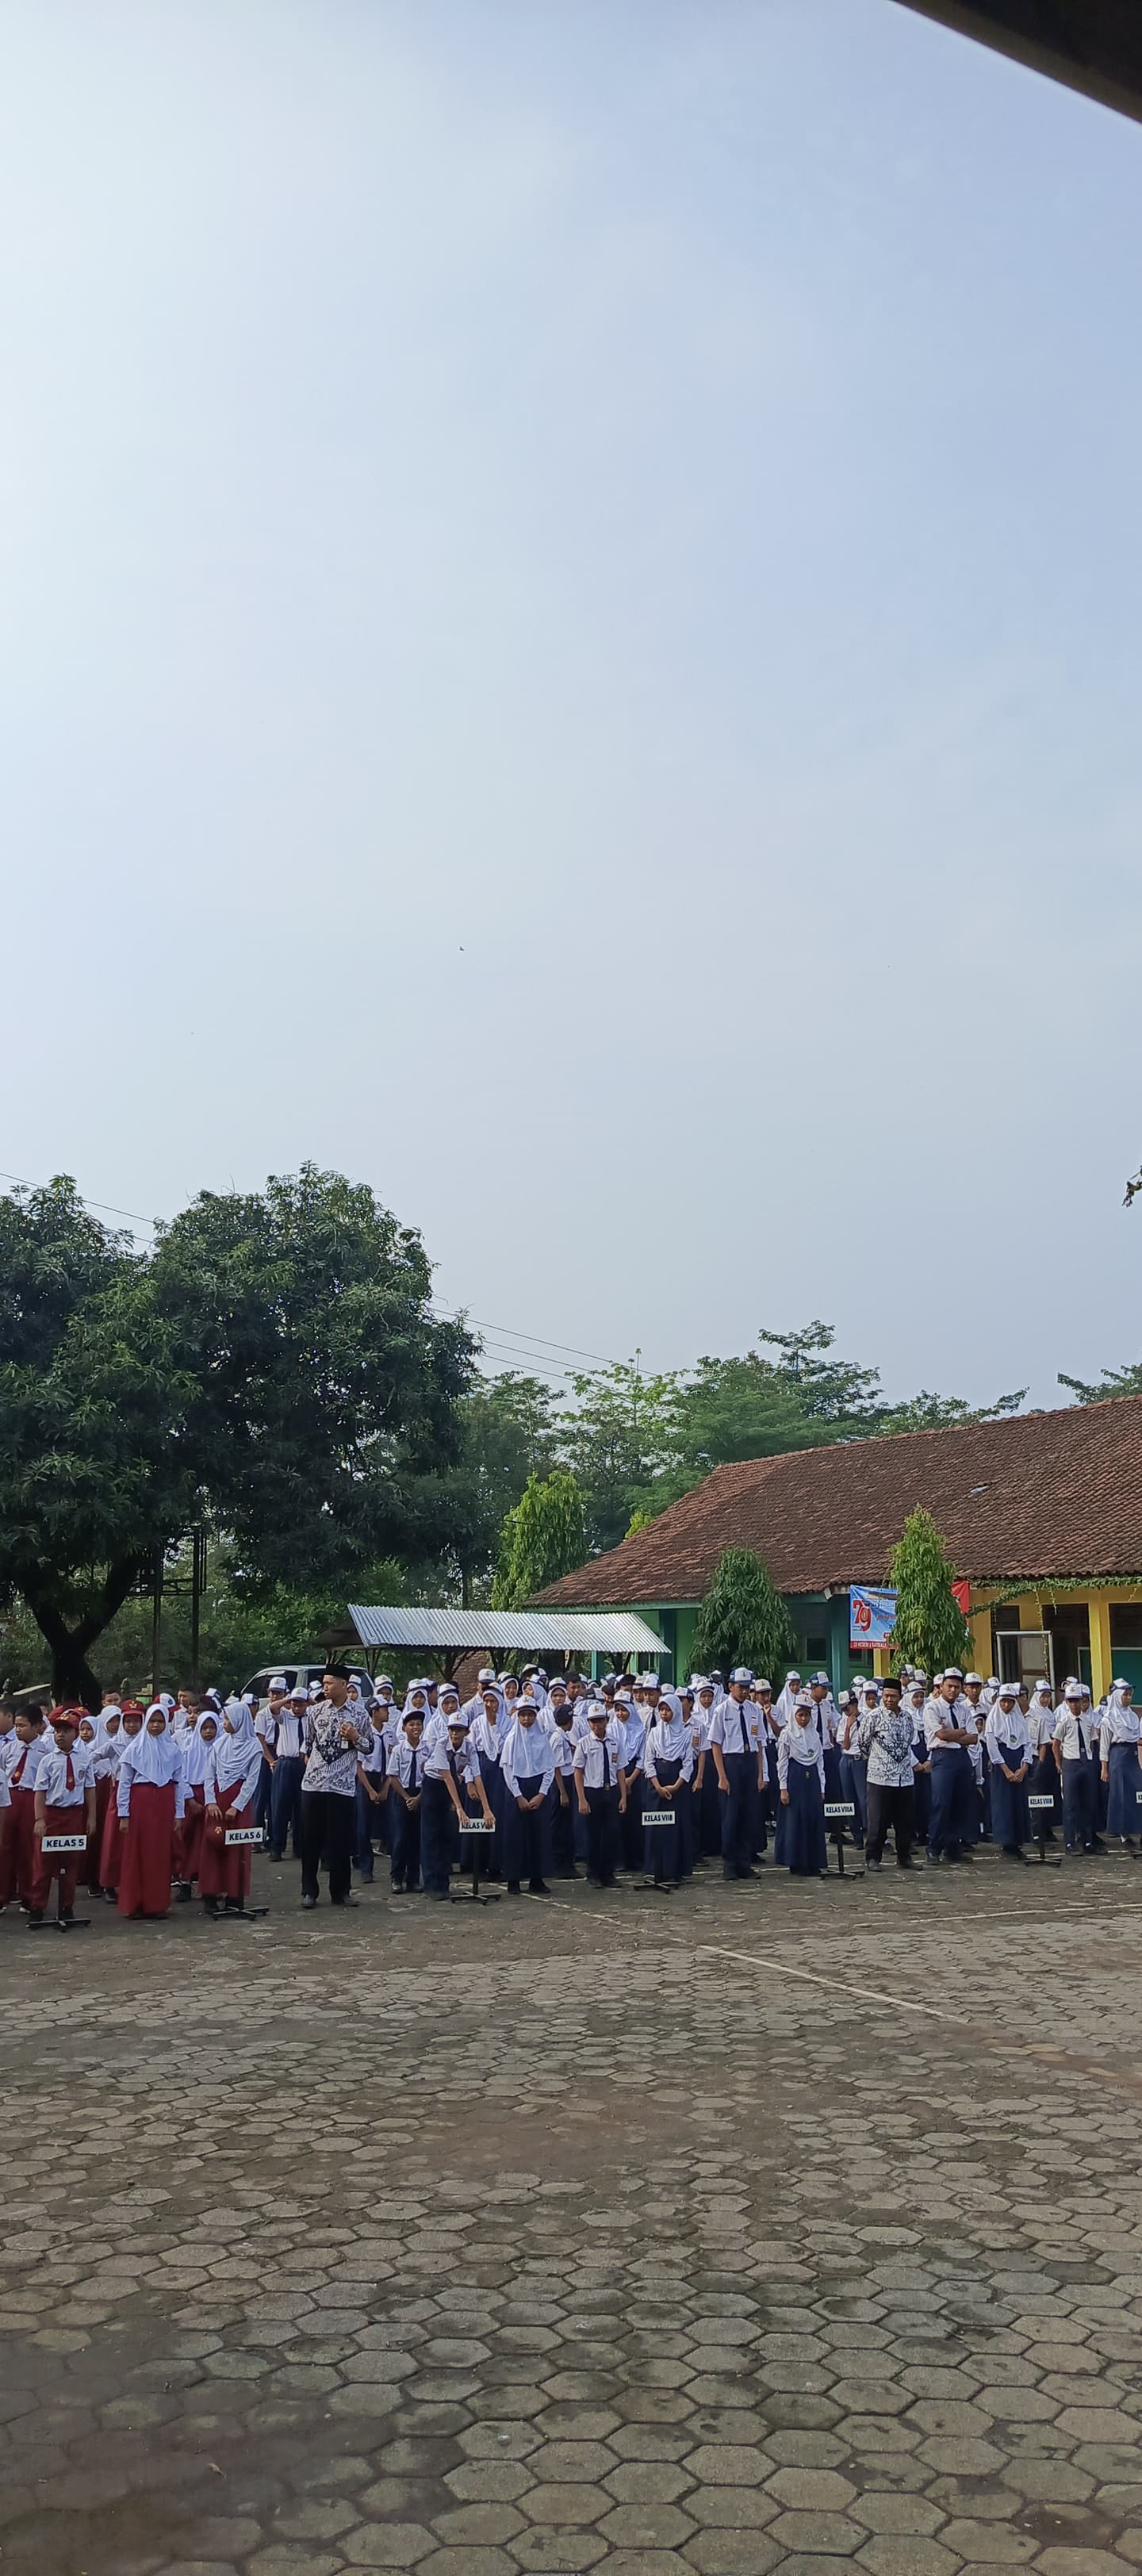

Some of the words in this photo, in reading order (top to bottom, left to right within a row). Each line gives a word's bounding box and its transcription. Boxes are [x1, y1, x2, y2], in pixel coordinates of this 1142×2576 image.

[853, 1599, 872, 1632] 79
[229, 1832, 254, 1841] KELAS
[46, 1839, 76, 1848] KELAS
